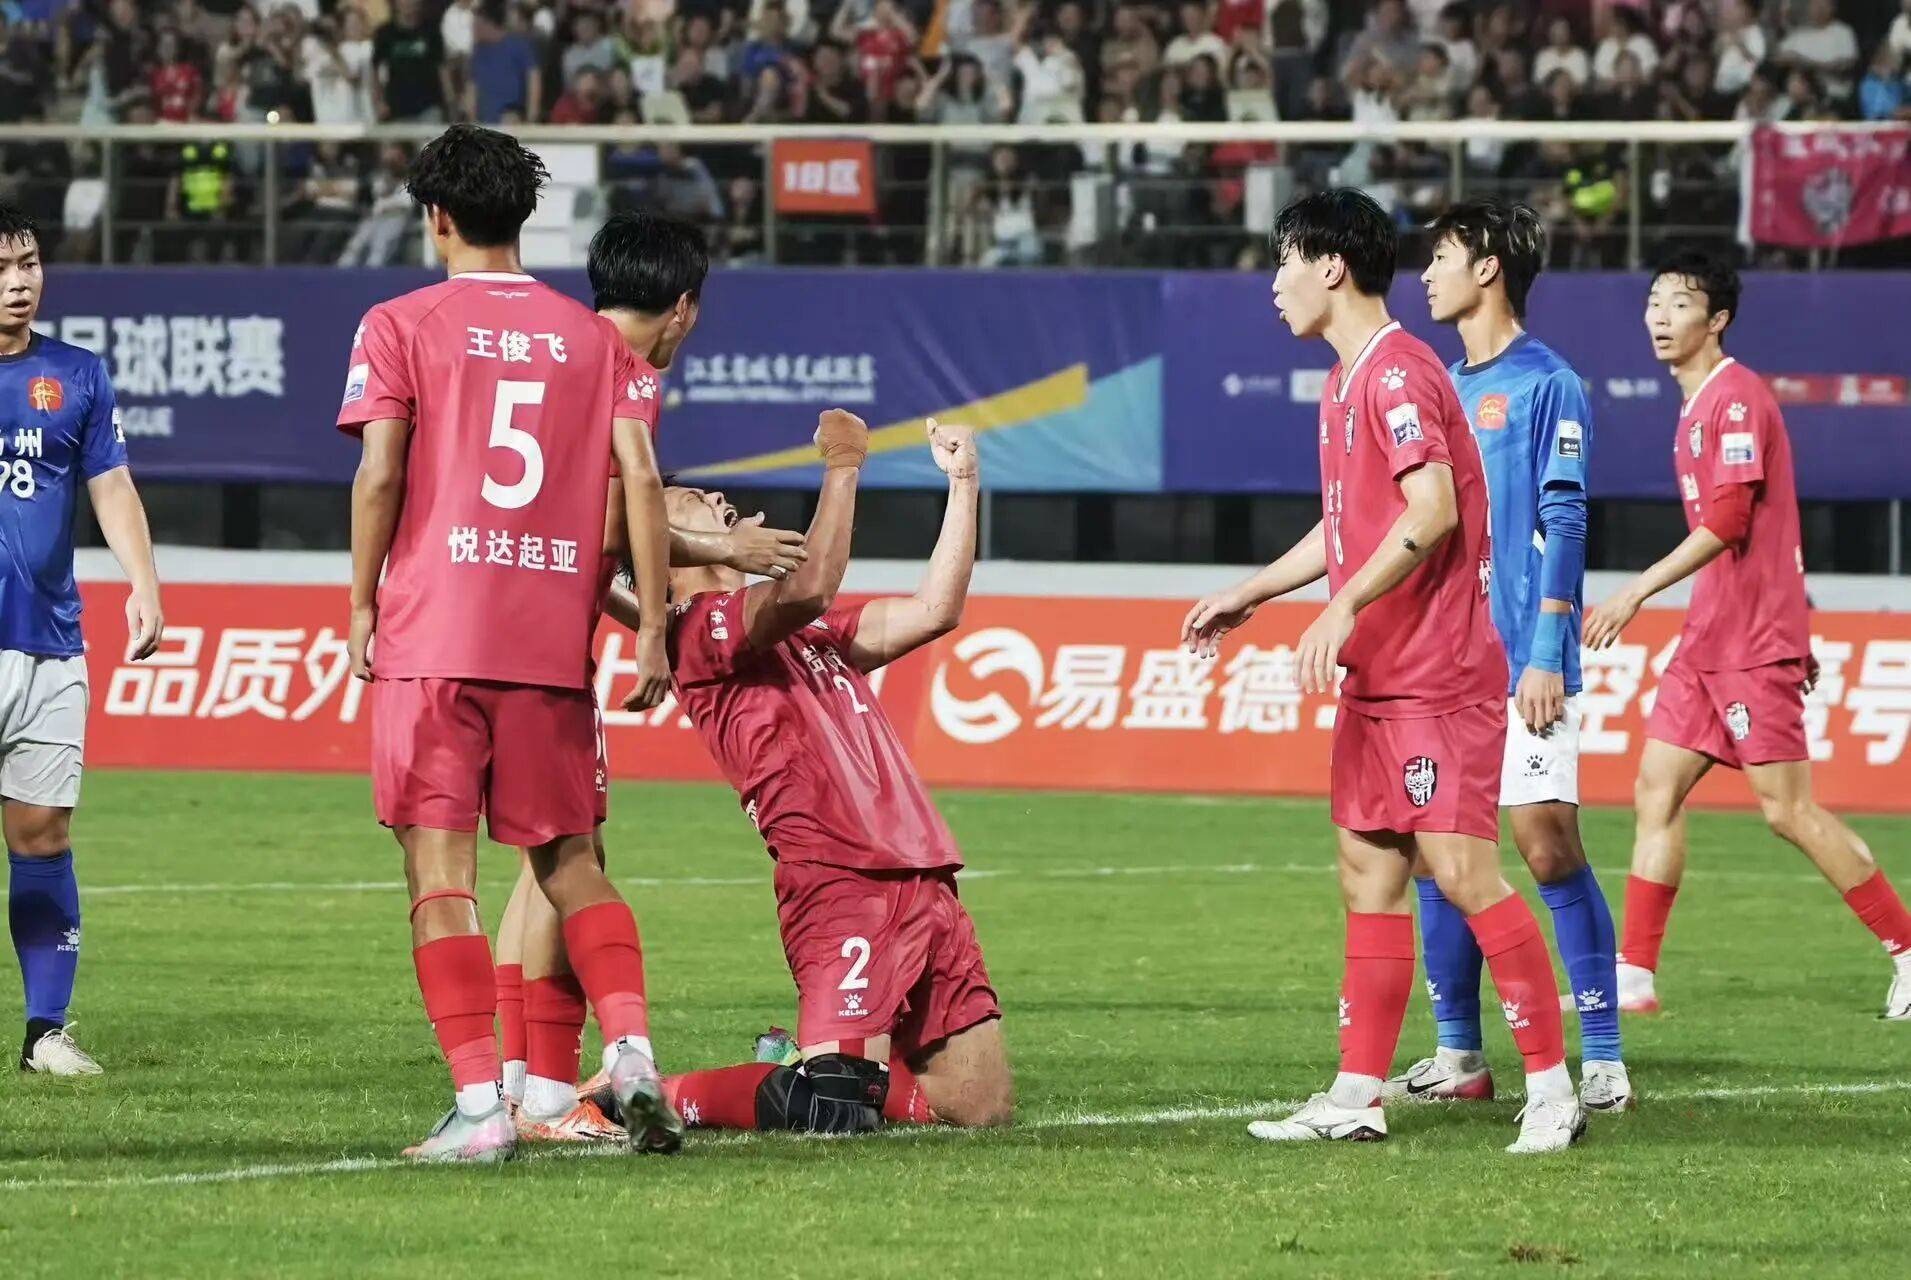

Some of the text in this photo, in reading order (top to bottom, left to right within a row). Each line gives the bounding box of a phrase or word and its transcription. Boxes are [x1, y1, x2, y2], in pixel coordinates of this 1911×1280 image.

[466, 326, 568, 363] 王俊飞
[481, 379, 545, 509] 5
[448, 525, 579, 574] 悦达起亚
[833, 675, 869, 714] 2
[1034, 644, 1346, 733] 易盛德
[838, 936, 871, 990] 2
[838, 1009, 869, 1017] KELME
